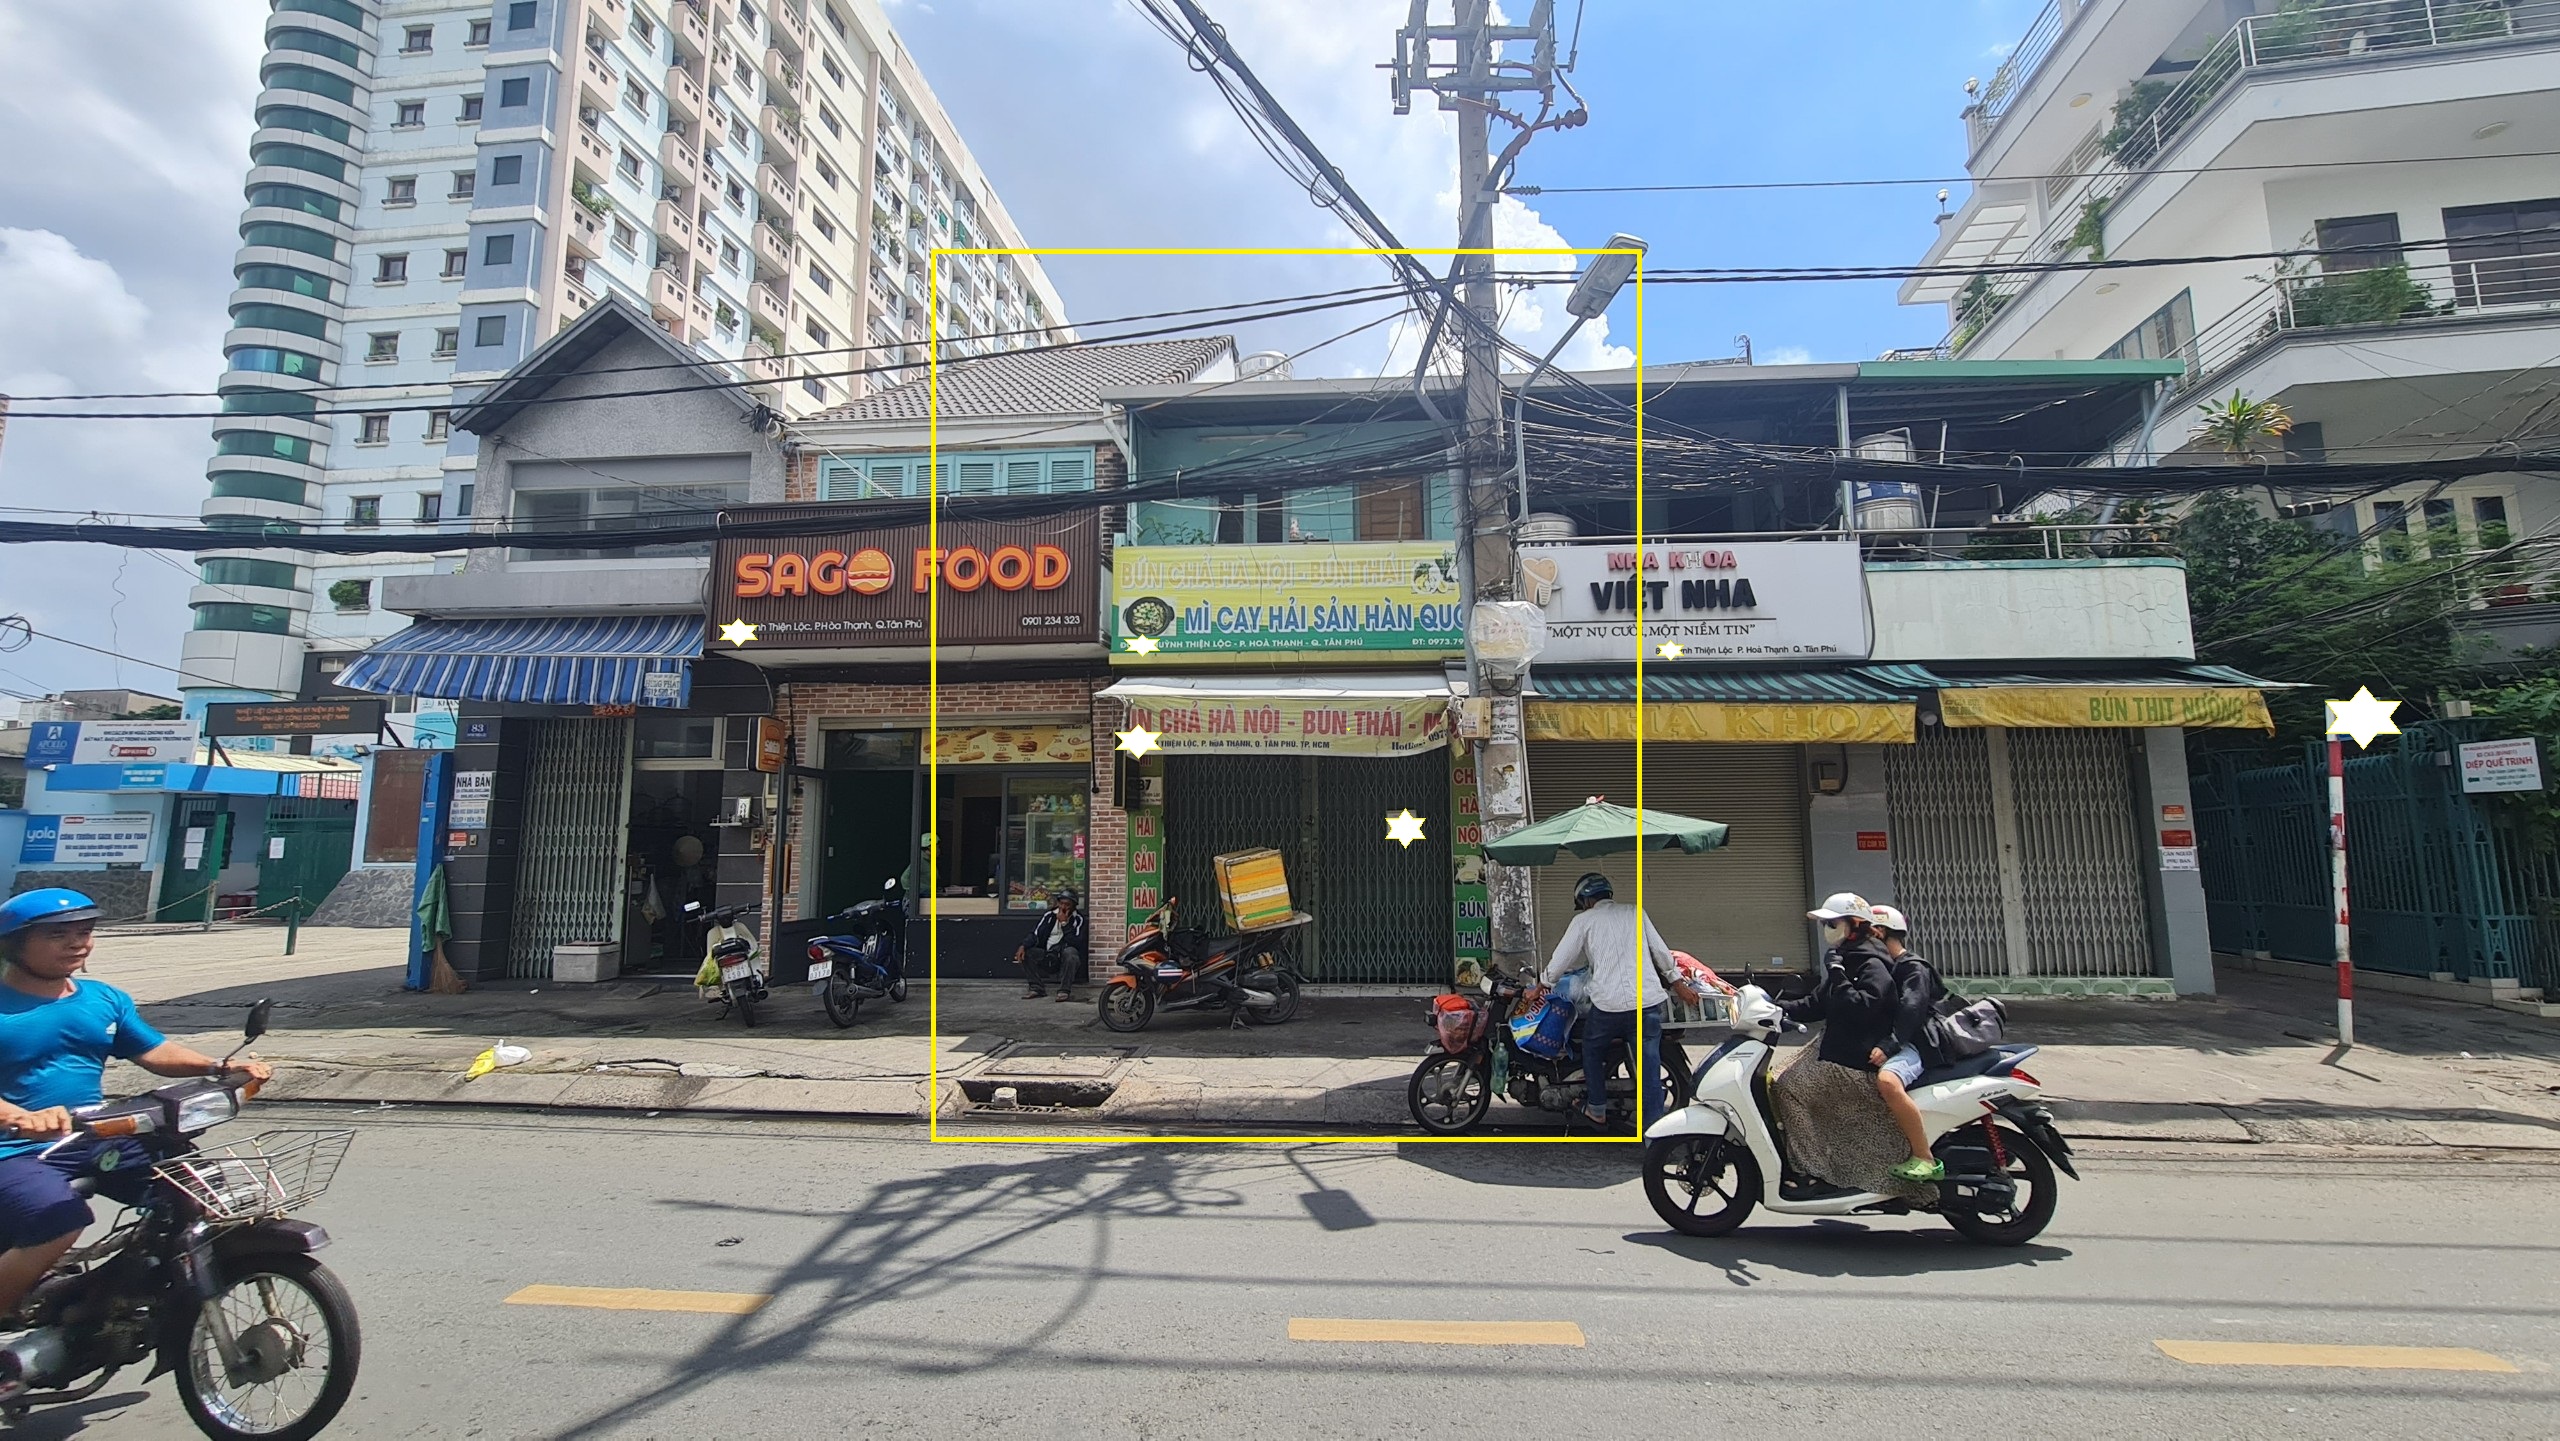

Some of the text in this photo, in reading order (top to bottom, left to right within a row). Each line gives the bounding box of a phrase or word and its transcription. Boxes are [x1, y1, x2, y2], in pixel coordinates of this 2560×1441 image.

[914, 545, 1071, 593] FOOD
[1608, 551, 1737, 570] NHA KHOA
[1121, 555, 1165, 590] BÚN
[1168, 553, 1215, 589] CHẢ
[1218, 555, 1249, 588] HÀ
[1254, 554, 1295, 594] NỘI
[1309, 554, 1350, 587] BÚN
[1355, 552, 1405, 586] THÁI
[1590, 573, 1757, 617] VIỆT NHA
[1022, 616, 1080, 625] 0901 234 323
[1185, 599, 1211, 634] MÌ
[1217, 605, 1264, 634] CAY
[1268, 596, 1308, 633] HẢI
[1313, 595, 1359, 632] SẢN
[1365, 597, 1415, 631] HÀN
[1586, 626, 1607, 638] NỤ
[1649, 624, 1679, 638] MỘT
[1684, 621, 1719, 636] NIỀM
[1158, 639, 1182, 648] UỲNH
[1185, 639, 1210, 648] THIỆN
[1213, 638, 1232, 648] LỘC
[1272, 640, 1303, 648] THẠNH
[1345, 637, 1363, 645] PHÚ
[1159, 701, 1201, 733] CHẢ
[1208, 704, 1236, 733] HÀ
[1244, 704, 1281, 739] NỘI
[1303, 705, 1347, 735] BÚN
[1354, 706, 1402, 737] THÁI
[2089, 690, 2128, 721] BÚN
[2132, 697, 2174, 726] THỊT
[471, 723, 484, 732] 83
[475, 773, 491, 787] BÁN
[1453, 768, 1477, 784] CH
[27, 826, 56, 842] yola
[1135, 809, 1155, 837] HẢI
[1457, 822, 1482, 848] NỘI
[1134, 844, 1156, 872] SẢN
[1133, 881, 1156, 908] HÀN
[1458, 896, 1487, 918] BÚN
[1456, 926, 1488, 948] THÁI
